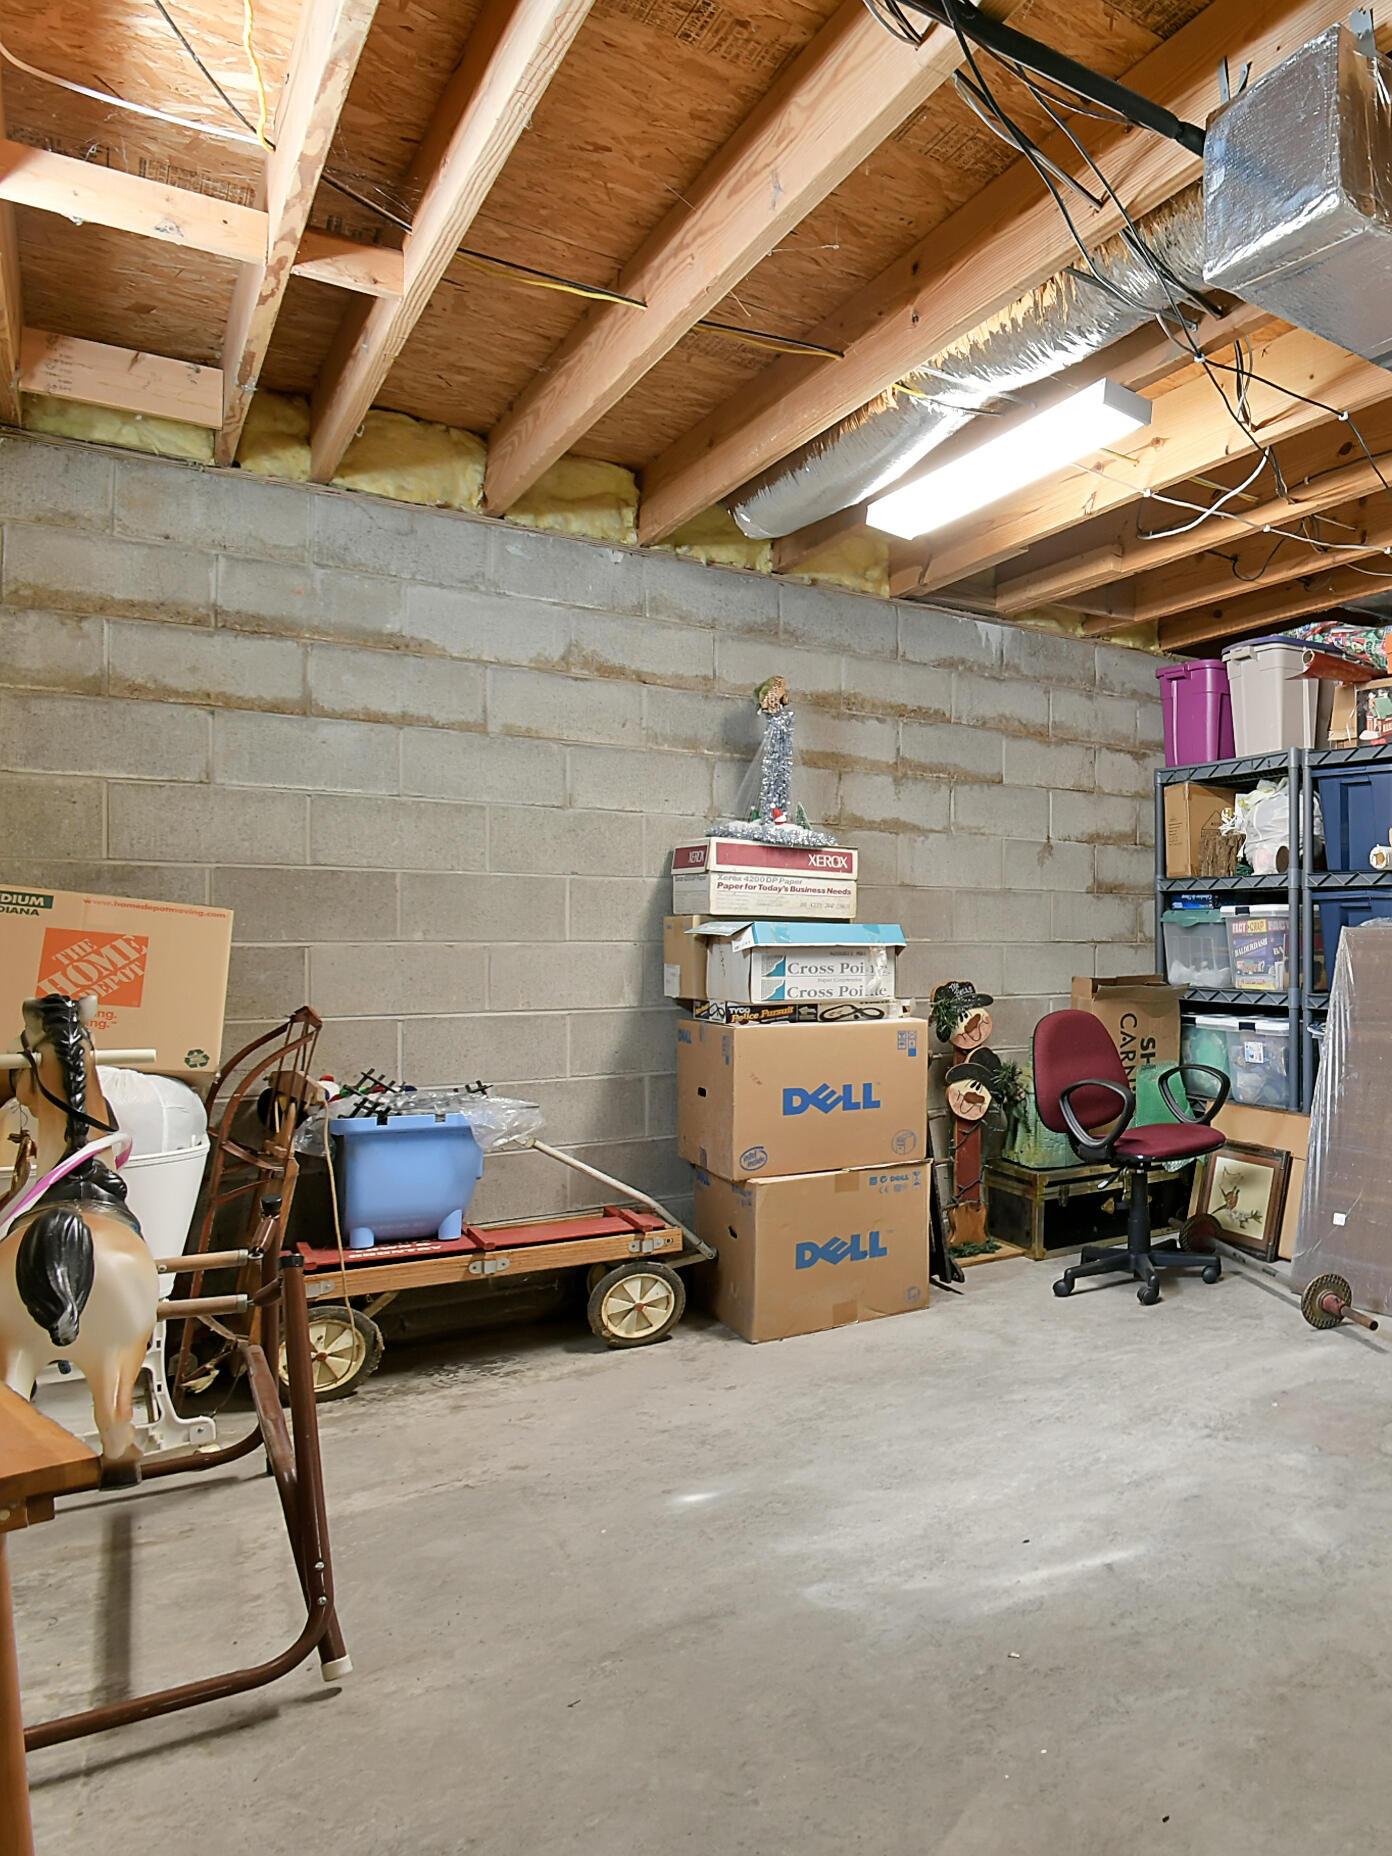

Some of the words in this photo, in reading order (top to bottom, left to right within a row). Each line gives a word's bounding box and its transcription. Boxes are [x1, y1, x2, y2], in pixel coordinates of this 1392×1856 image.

[808, 853, 848, 869] XEROX
[716, 882, 743, 892] Paper
[744, 883, 757, 891] for
[758, 884, 789, 895] Today's
[790, 886, 826, 895] Business
[826, 888, 852, 896] Needs
[778, 877, 803, 886] Paper
[51, 938, 98, 966] THE
[37, 934, 148, 997] HOME
[787, 962, 835, 975] Cross
[77, 961, 145, 998] DEPOT
[786, 985, 834, 998] Cross
[731, 1012, 760, 1023] Police
[782, 1082, 881, 1116] DELL
[795, 1230, 888, 1270] DELL
